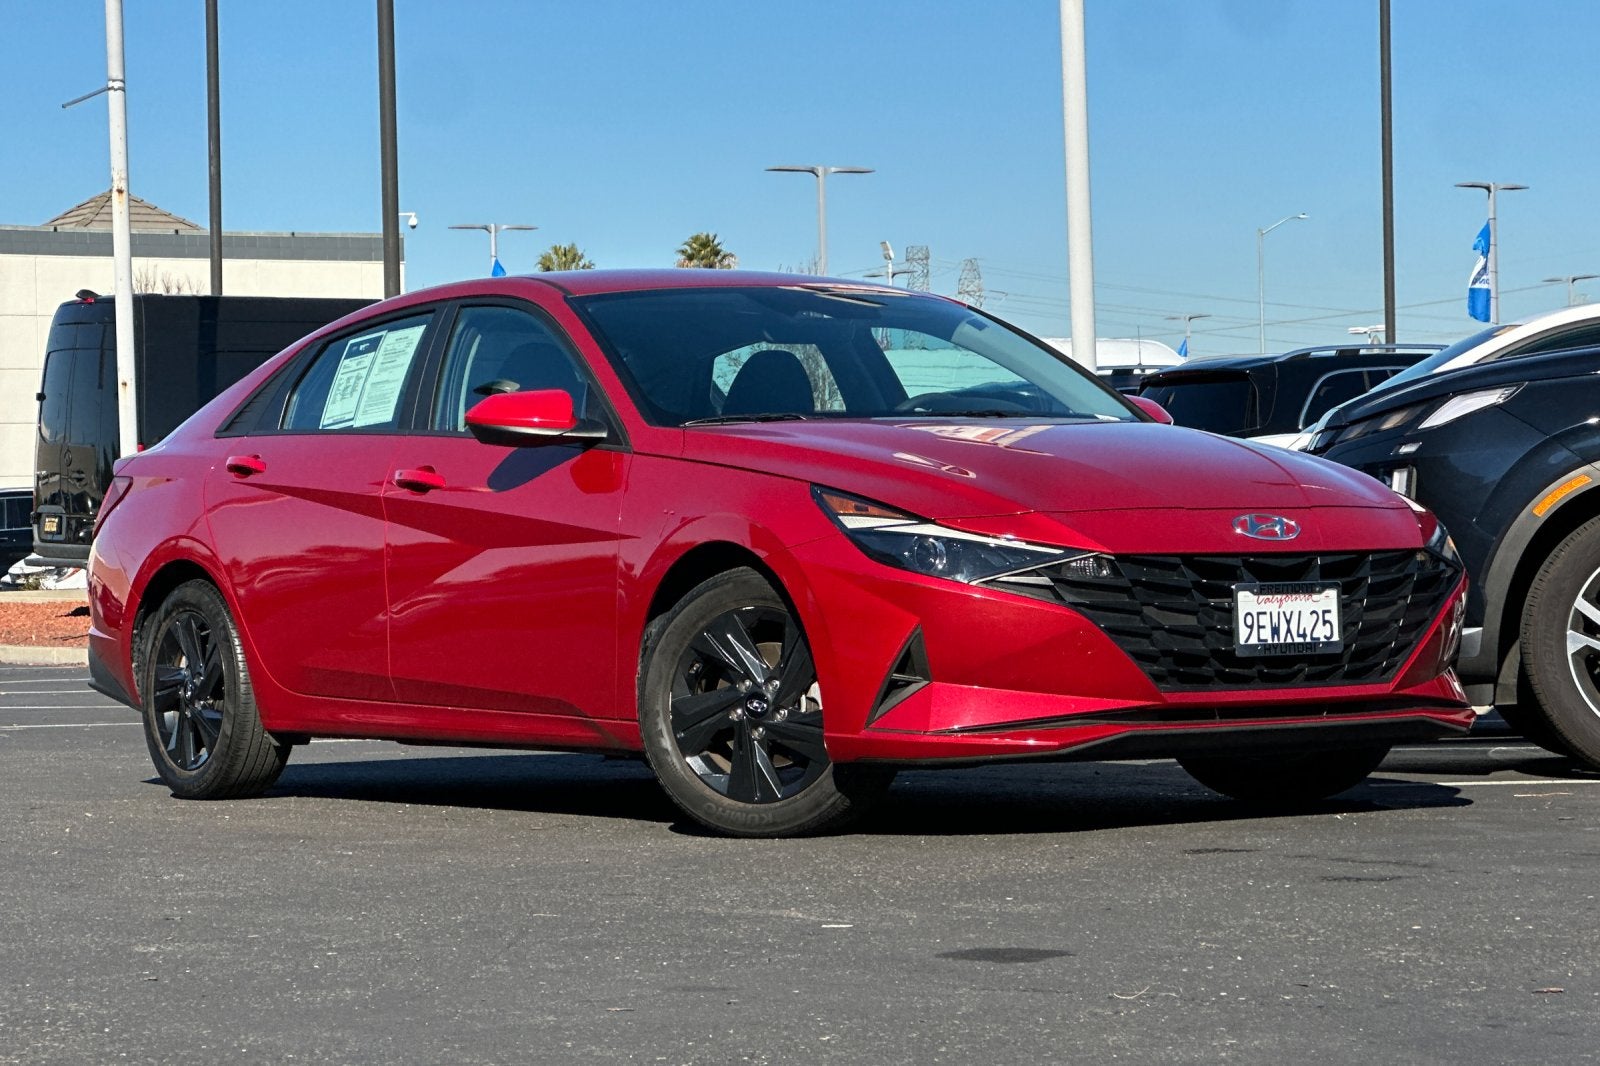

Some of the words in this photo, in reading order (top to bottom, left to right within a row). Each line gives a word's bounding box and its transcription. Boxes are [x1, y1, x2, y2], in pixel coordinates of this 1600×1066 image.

[1259, 583, 1314, 593] FREMONT
[1257, 593, 1321, 609] California
[1243, 609, 1333, 643] 9EWX425
[1264, 642, 1316, 654] HYUNDAI
[703, 802, 773, 825] KUMHO
